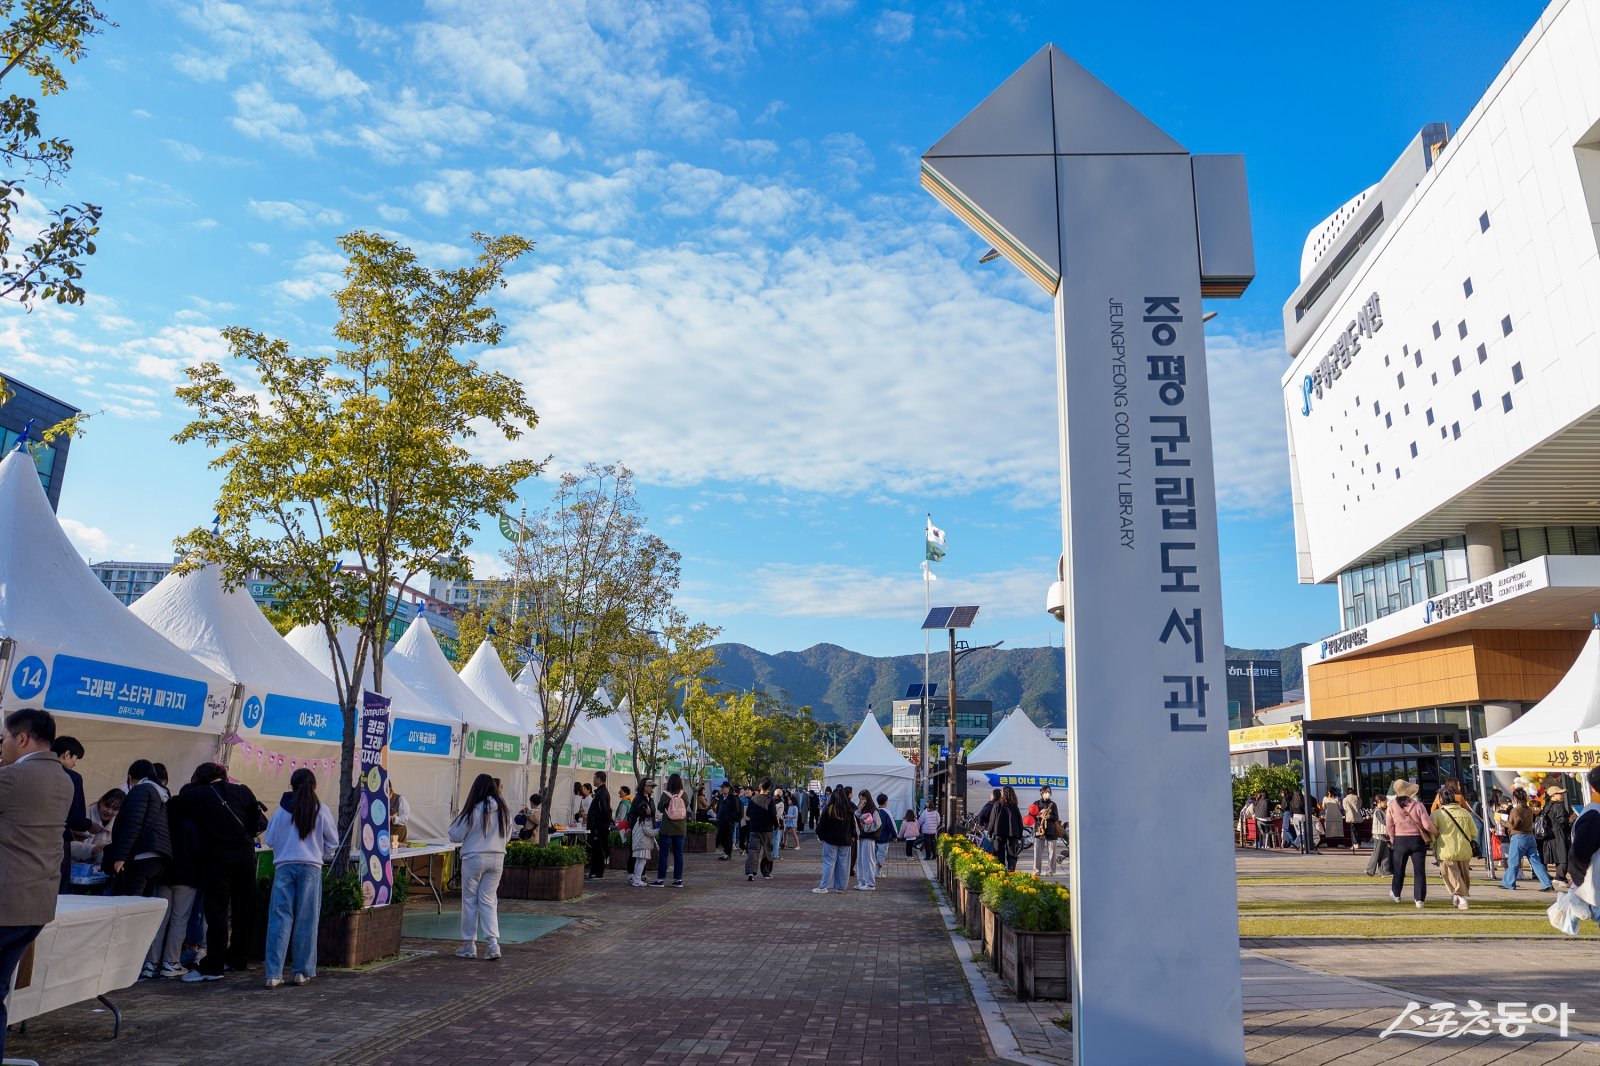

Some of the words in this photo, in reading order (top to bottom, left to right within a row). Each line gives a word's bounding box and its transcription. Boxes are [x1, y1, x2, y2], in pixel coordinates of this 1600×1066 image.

[1109, 298, 1128, 407] JEUNGPYEONG
[1311, 291, 1383, 400] 증평군립도서관
[1114, 412, 1131, 478] COUNTY
[1118, 483, 1135, 550] LIBRARY
[1143, 297, 1209, 732] 증평군립도서관
[1498, 571, 1527, 587] JEUNGPYEONG
[1498, 585, 1515, 596] COUNTY
[1514, 579, 1533, 591] LIBRARY
[1435, 581, 1494, 619] 증평군립도서관
[22, 666, 41, 689] 14
[77, 676, 116, 699] 그래픽
[118, 685, 151, 706] 스티커
[155, 689, 187, 710] 패키지
[247, 704, 260, 720] 13
[1548, 751, 1569, 766] 나와
